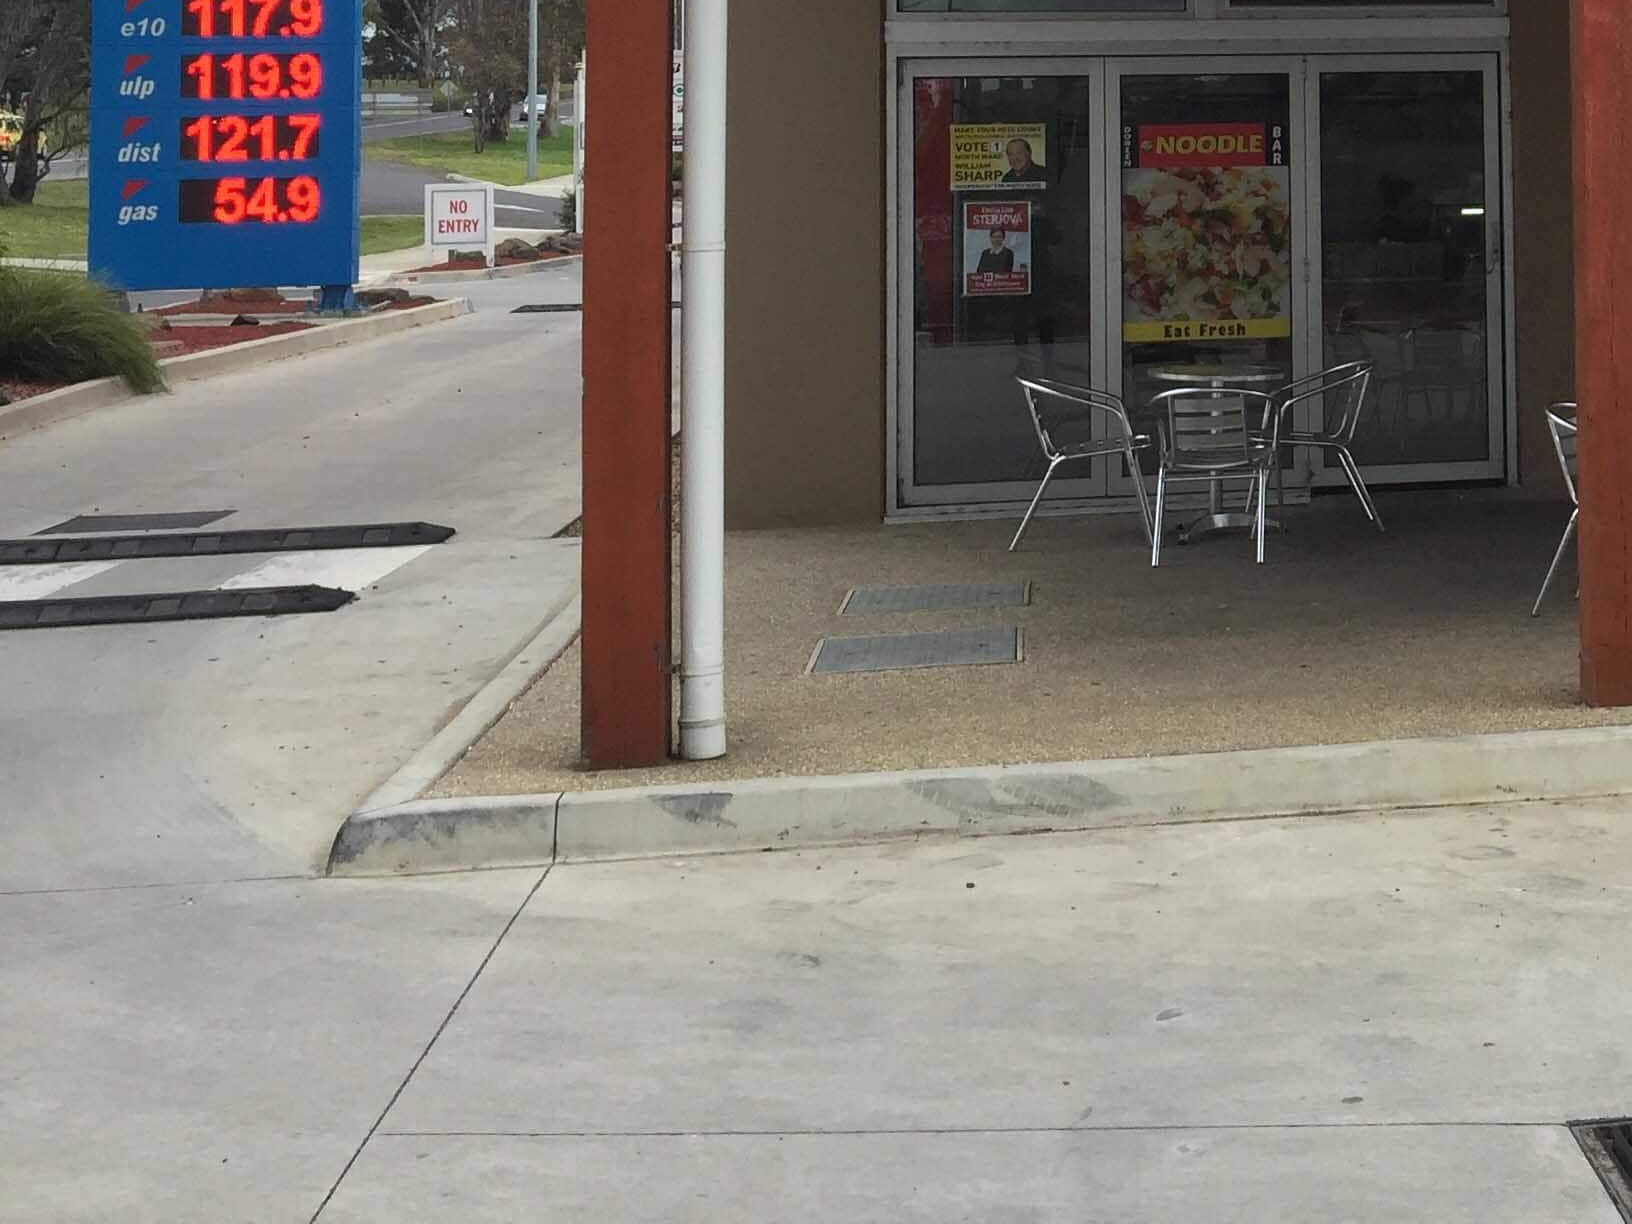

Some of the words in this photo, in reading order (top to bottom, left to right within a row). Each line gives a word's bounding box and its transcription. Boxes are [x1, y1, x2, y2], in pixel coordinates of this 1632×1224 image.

[120, 17, 165, 37] e10
[119, 75, 154, 99] ulp
[187, 53, 322, 99] 119.9
[118, 142, 161, 163] dist
[186, 113, 321, 163] 121.7
[955, 142, 988, 152] VOTE
[1156, 134, 1263, 154] NOODLE
[1272, 126, 1282, 164] BAR
[955, 170, 1003, 181] SHARP
[118, 204, 159, 225] gas
[214, 176, 320, 224] 54.9
[449, 200, 468, 214] NO
[438, 219, 479, 233] ENTRY
[1164, 325, 1191, 338] Eat
[1200, 323, 1246, 336] Fresh
